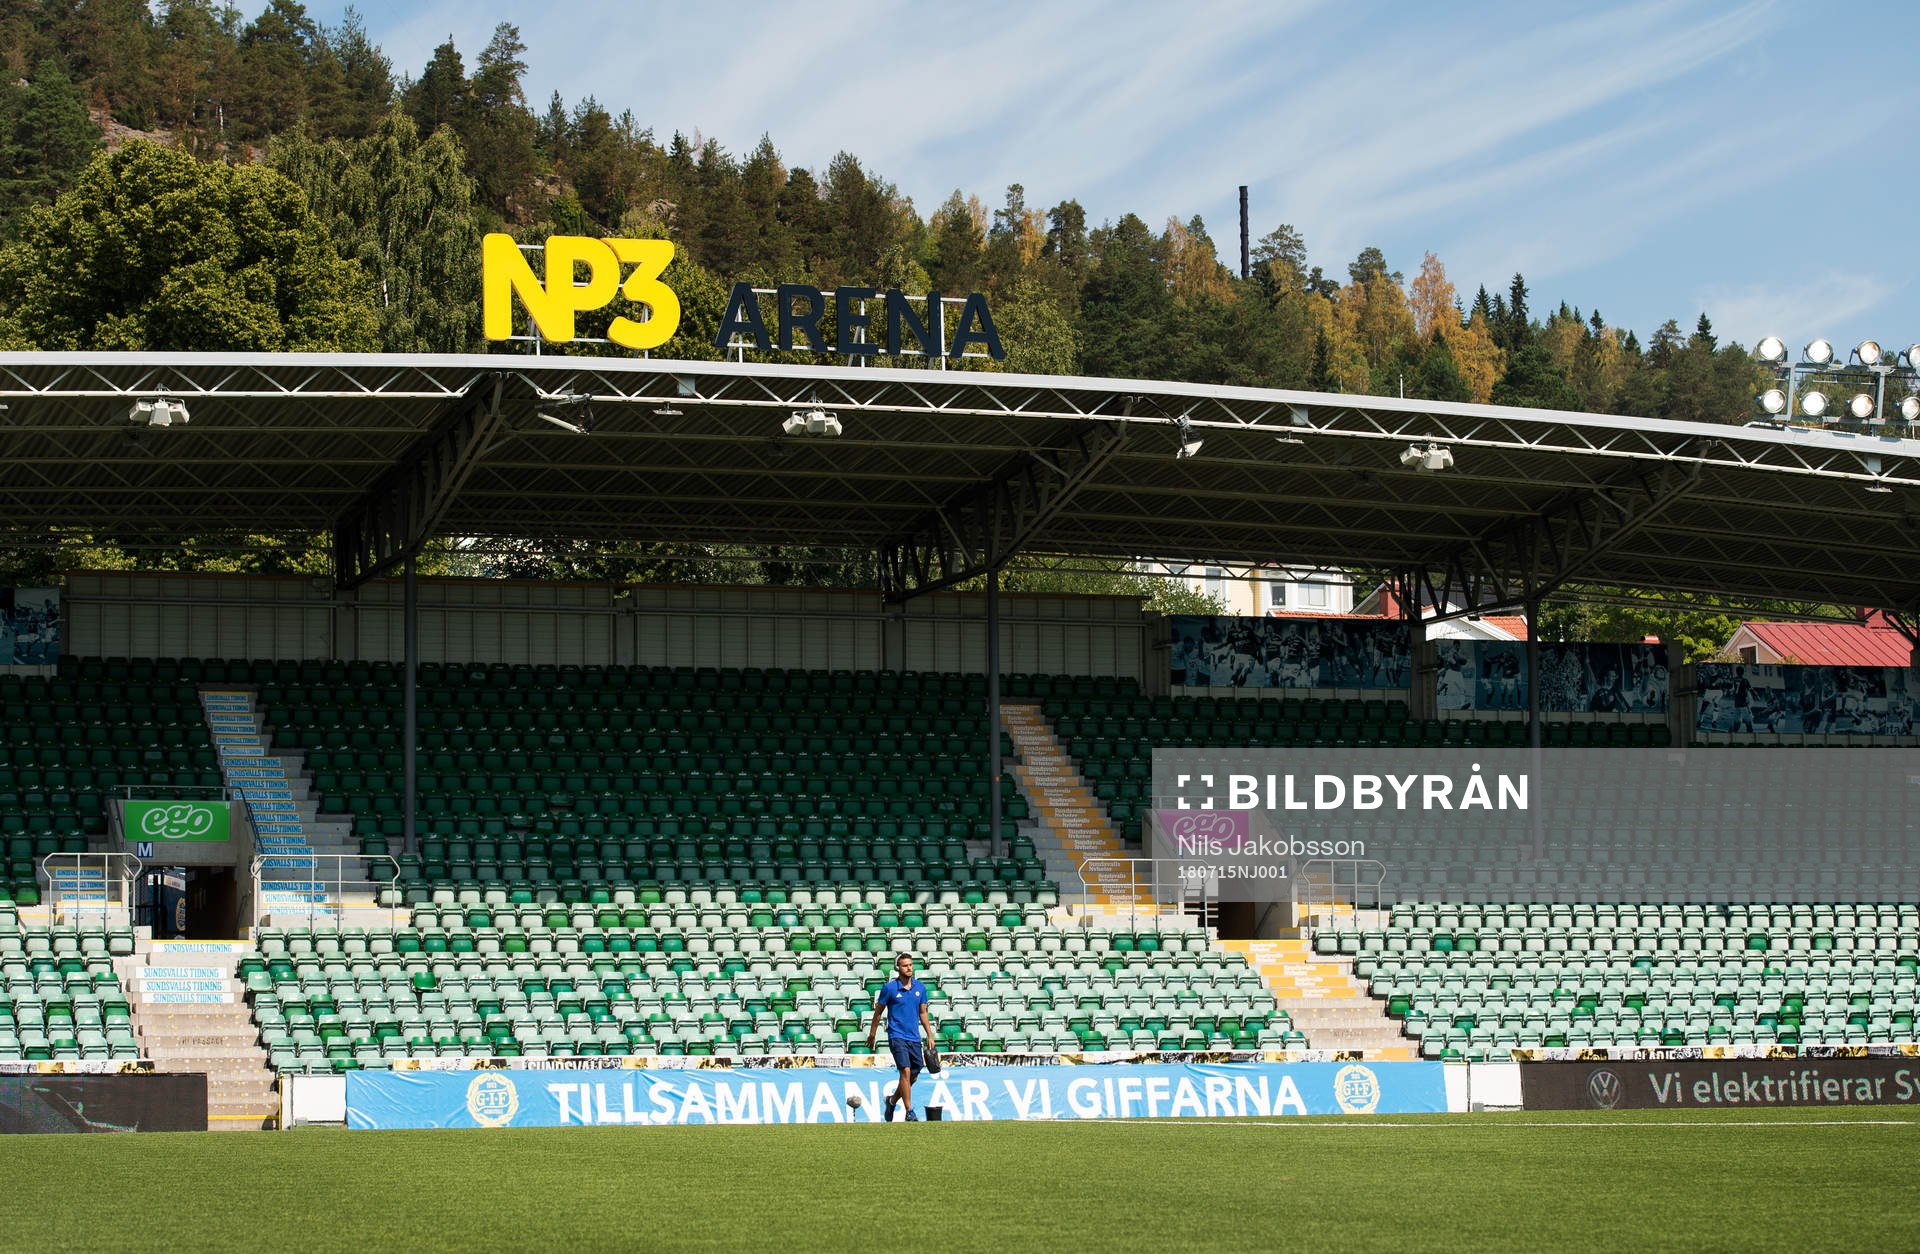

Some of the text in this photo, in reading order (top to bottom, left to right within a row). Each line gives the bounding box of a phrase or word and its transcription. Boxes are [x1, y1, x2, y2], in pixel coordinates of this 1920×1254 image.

[482, 232, 1006, 361] NP3 ARENA
[142, 804, 213, 838] ego
[1172, 813, 1235, 845] ego
[138, 842, 152, 856] M
[164, 944, 232, 952] SUNDSVALLS TIDNING
[144, 967, 218, 978] SUNDSVALLS TIDNING
[147, 981, 222, 991] SUNDSVALLS TIDNING
[153, 994, 223, 1003] SUNDSVALLS TIDNING
[926, 1070, 990, 1122] ÄR
[1002, 1079, 1050, 1120] VI
[1067, 1075, 1307, 1118] GIFFARNA
[1648, 1072, 1682, 1103] Vi
[1693, 1070, 1885, 1103] elektrifierar
